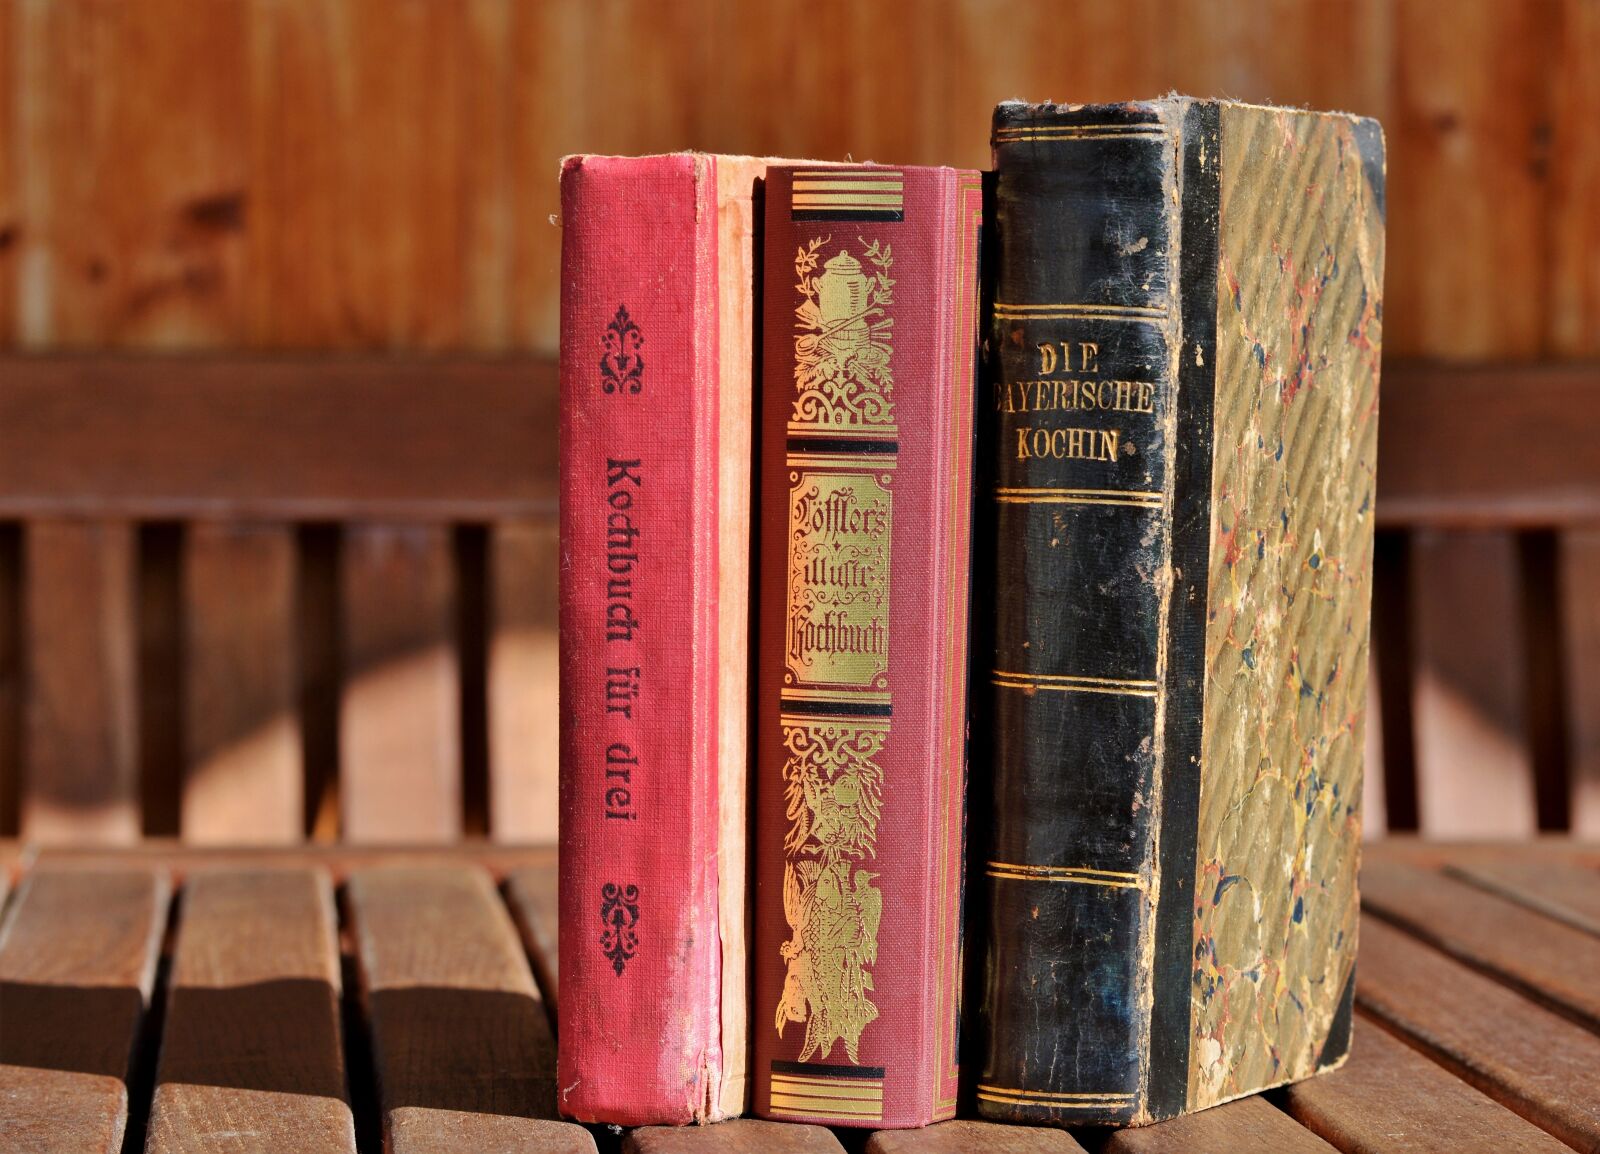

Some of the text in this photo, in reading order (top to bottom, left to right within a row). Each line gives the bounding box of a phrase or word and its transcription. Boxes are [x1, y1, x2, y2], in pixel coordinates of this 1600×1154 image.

[1038, 342, 1100, 376] DIE
[605, 458, 641, 823] Kochbuch für drei
[789, 601, 884, 666] Kochbuch
